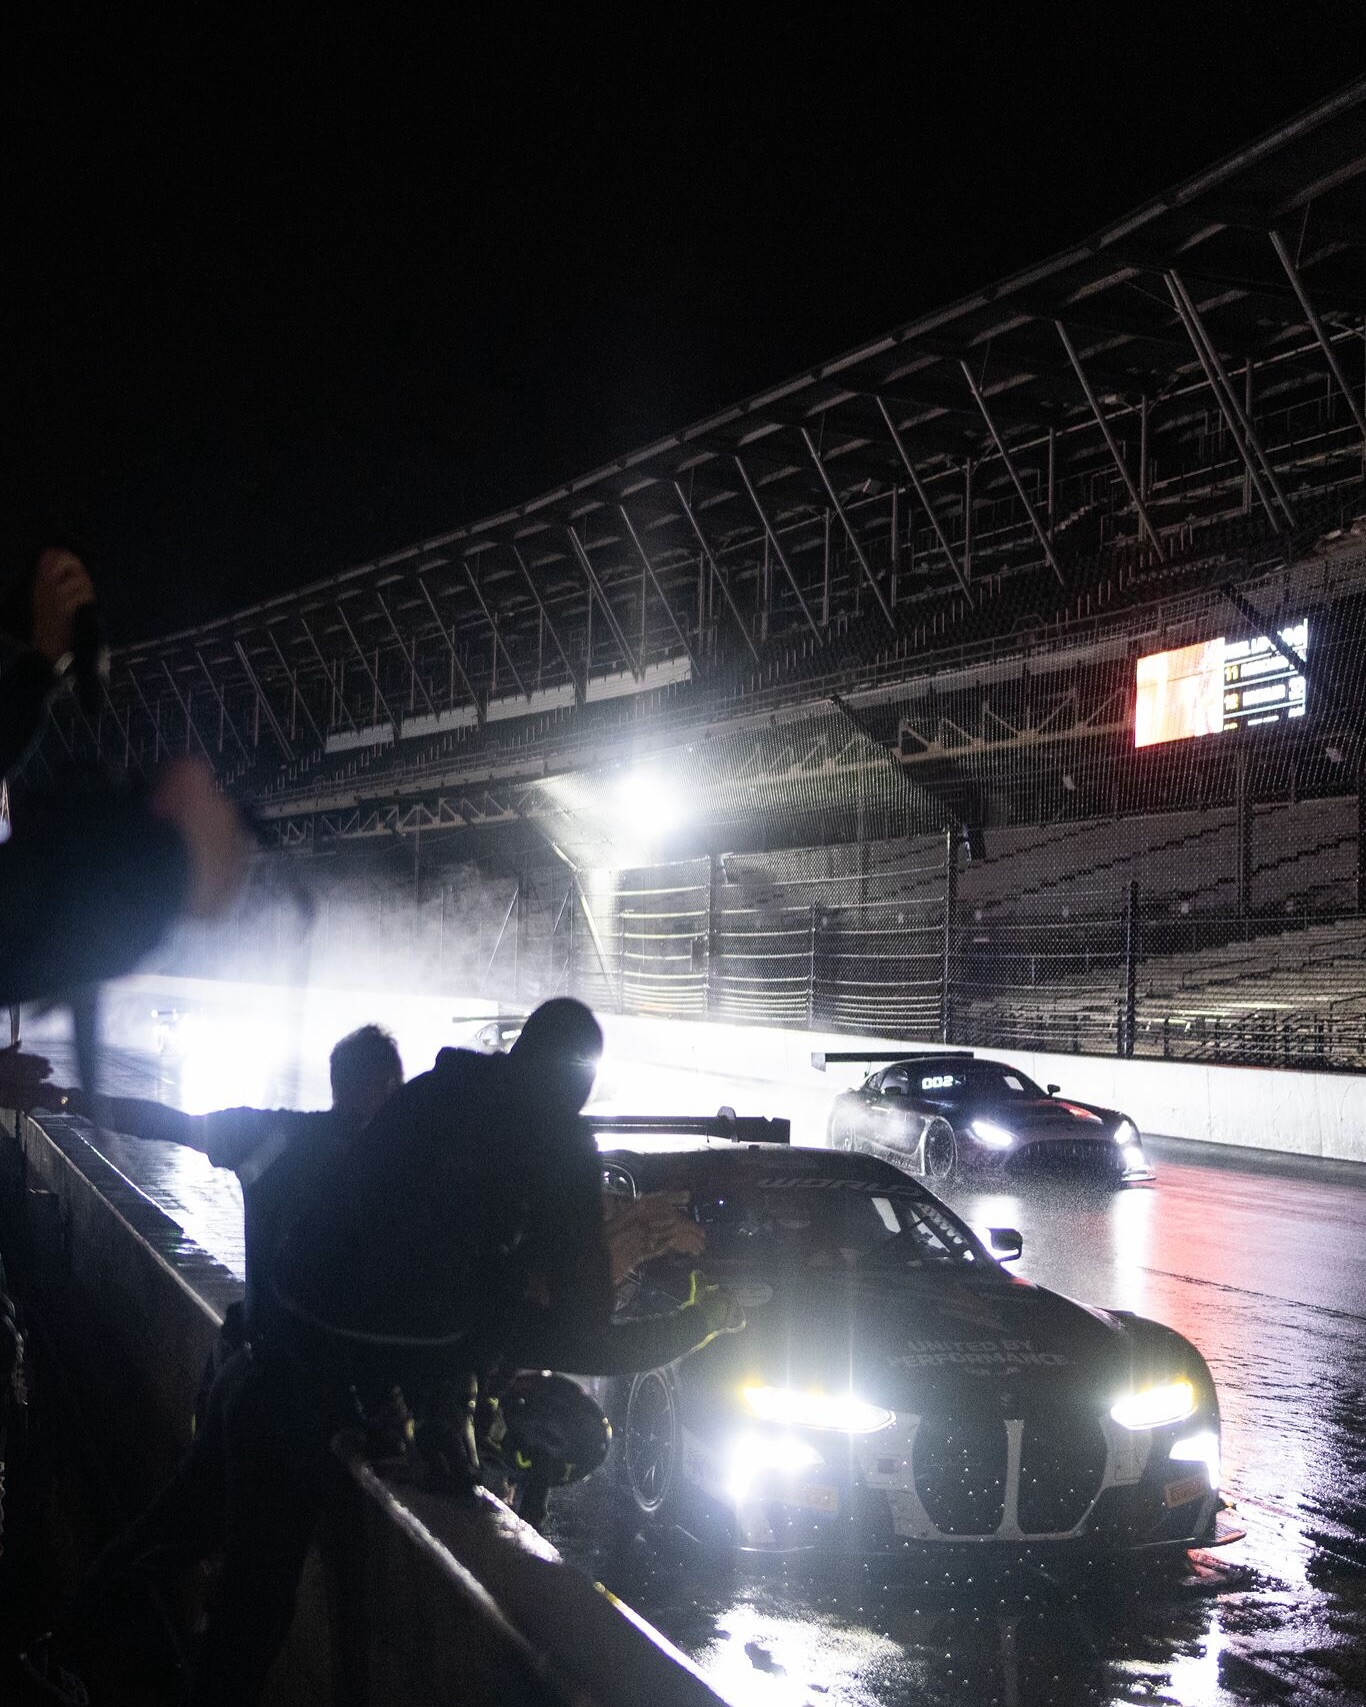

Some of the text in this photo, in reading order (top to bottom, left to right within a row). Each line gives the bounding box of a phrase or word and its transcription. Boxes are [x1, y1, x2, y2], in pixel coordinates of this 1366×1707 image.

[921, 1075, 954, 1090] 002
[907, 1339, 1032, 1352] UNITED BY
[886, 1352, 1068, 1367] PERFORMANCE
